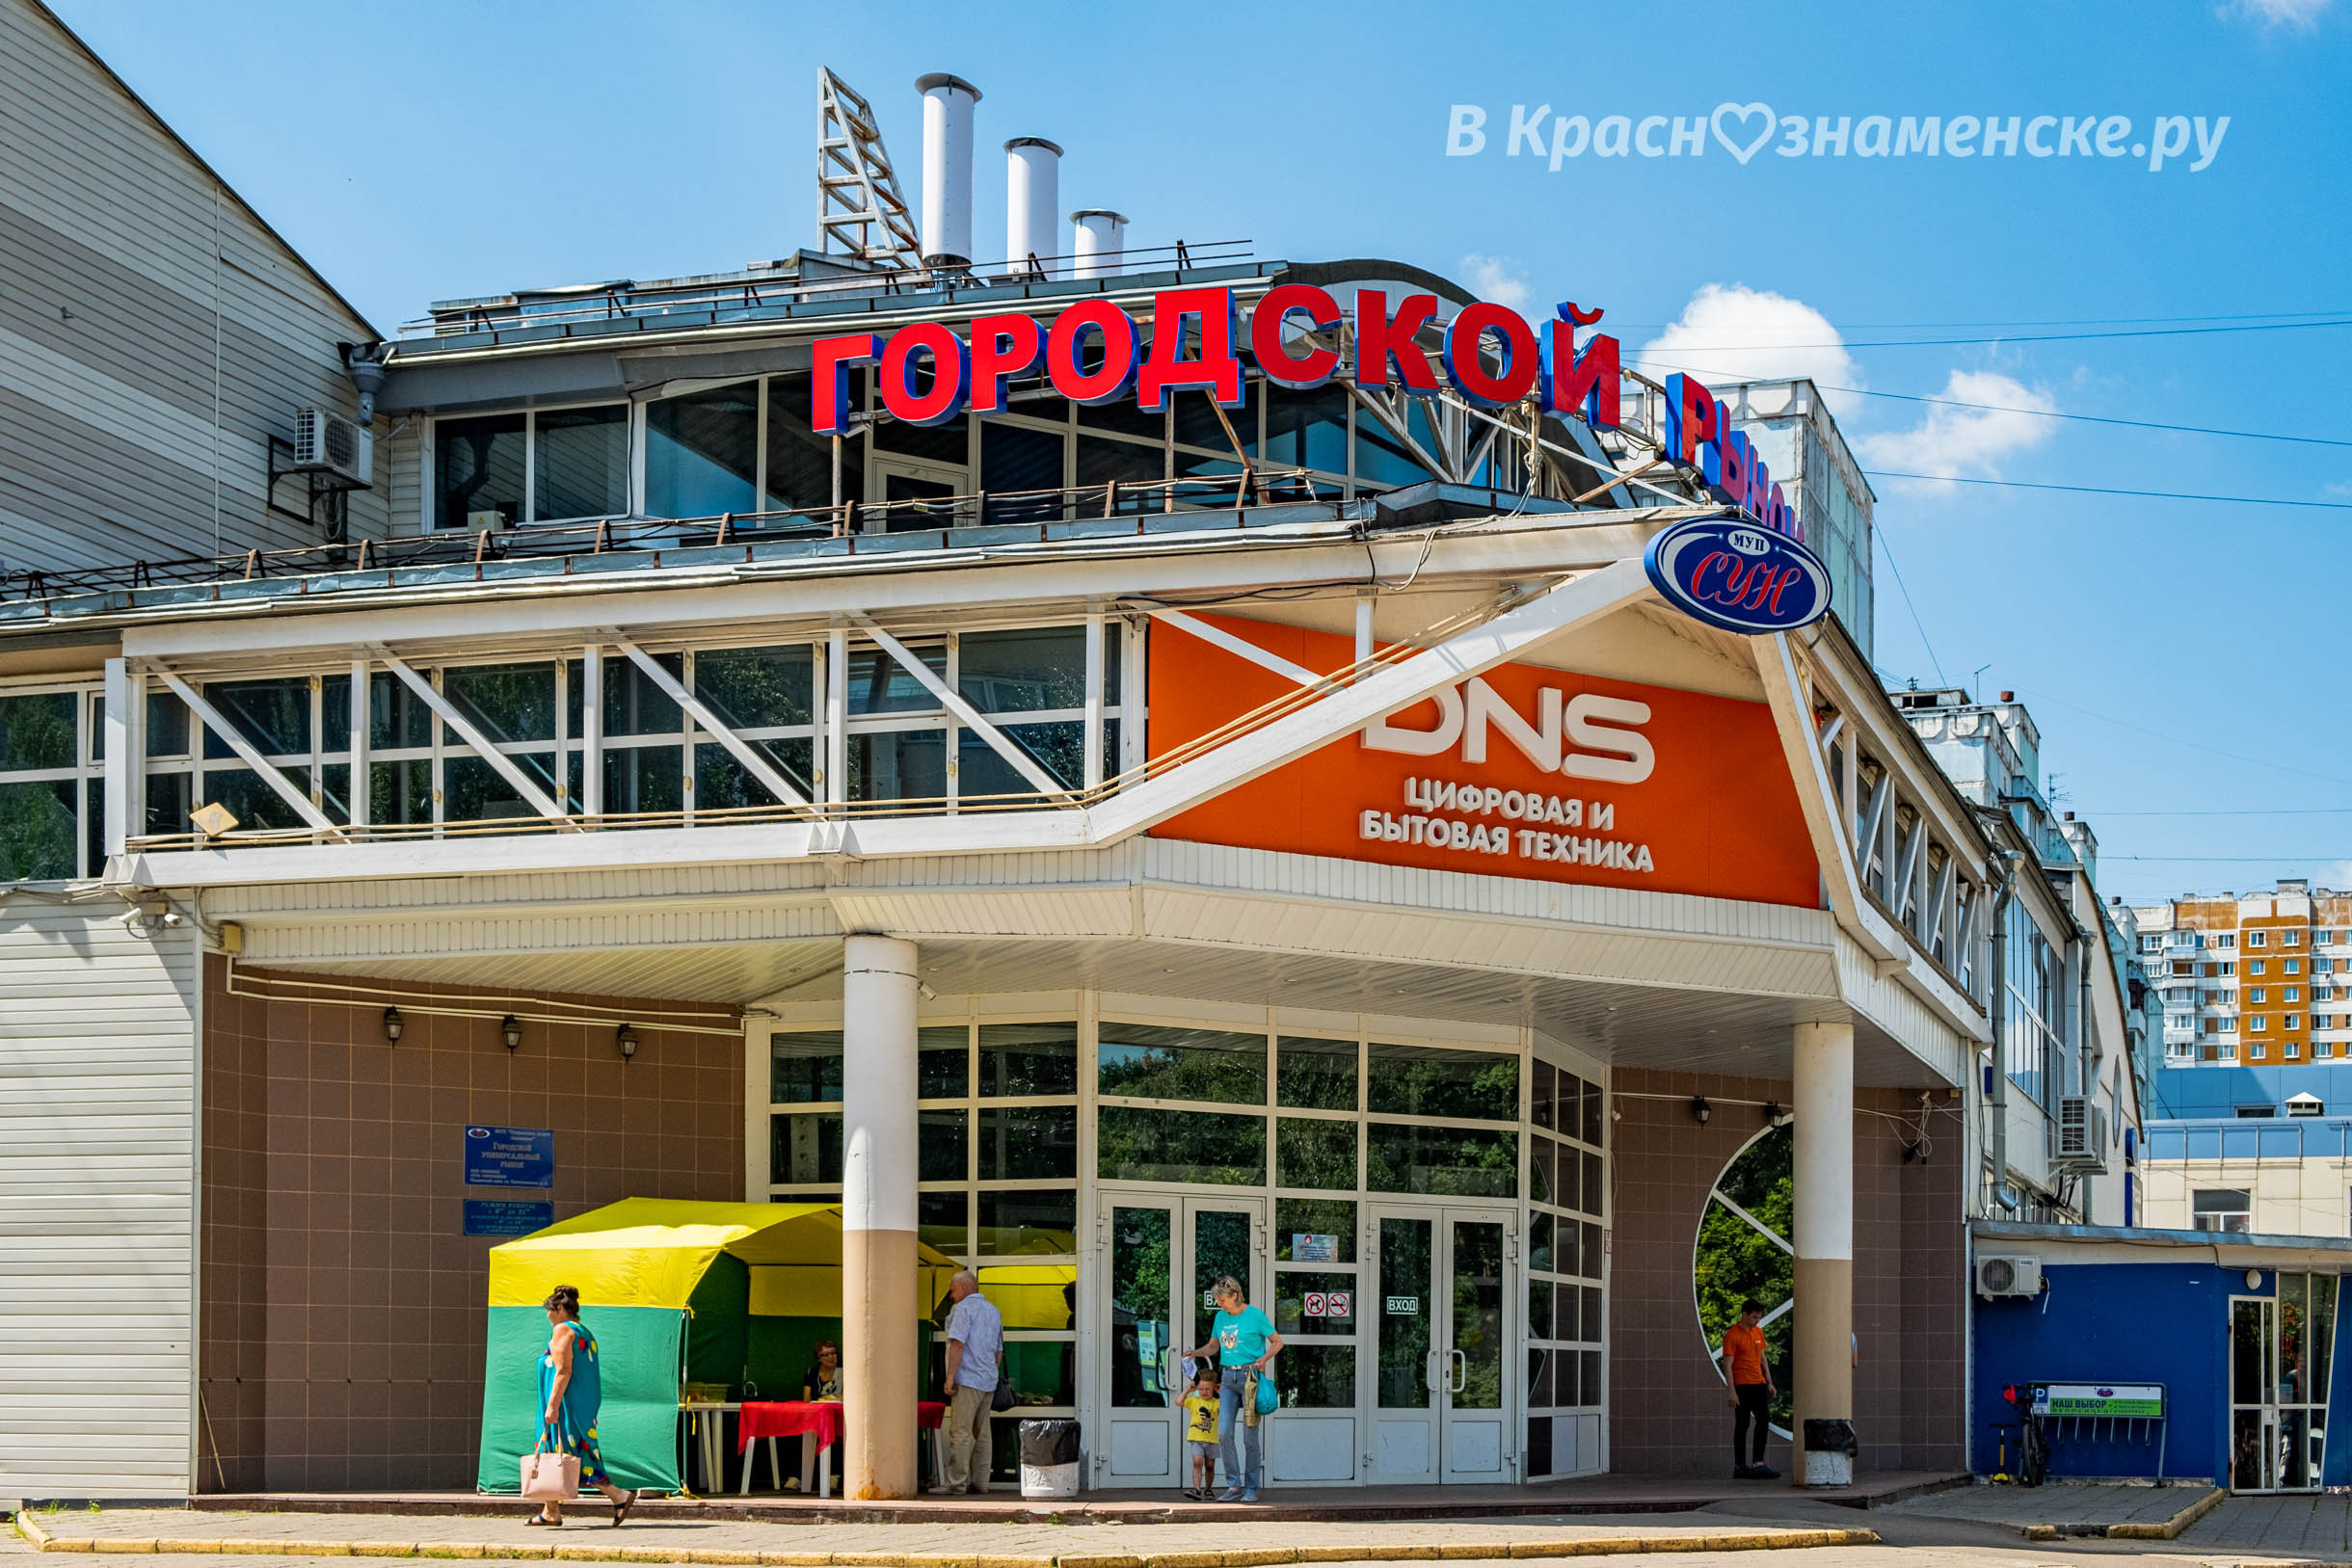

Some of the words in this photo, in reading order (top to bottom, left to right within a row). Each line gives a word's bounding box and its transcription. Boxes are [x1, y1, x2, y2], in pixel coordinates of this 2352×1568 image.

[812, 283, 1620, 437] ГОРОДСКОЙ
[1734, 534, 1764, 551] МУП
[1691, 551, 1801, 617] СУН
[1360, 661, 1655, 784] DNS
[1403, 777, 1583, 828] ЦИФРОВАЯ
[1589, 801, 1614, 831] И
[1359, 810, 1510, 855] БЫТОВАЯ
[1514, 829, 1654, 872] ТЕХНИКА
[1389, 1299, 1416, 1311] ВХОД
[2075, 1399, 2106, 1408] ВЫБОР
